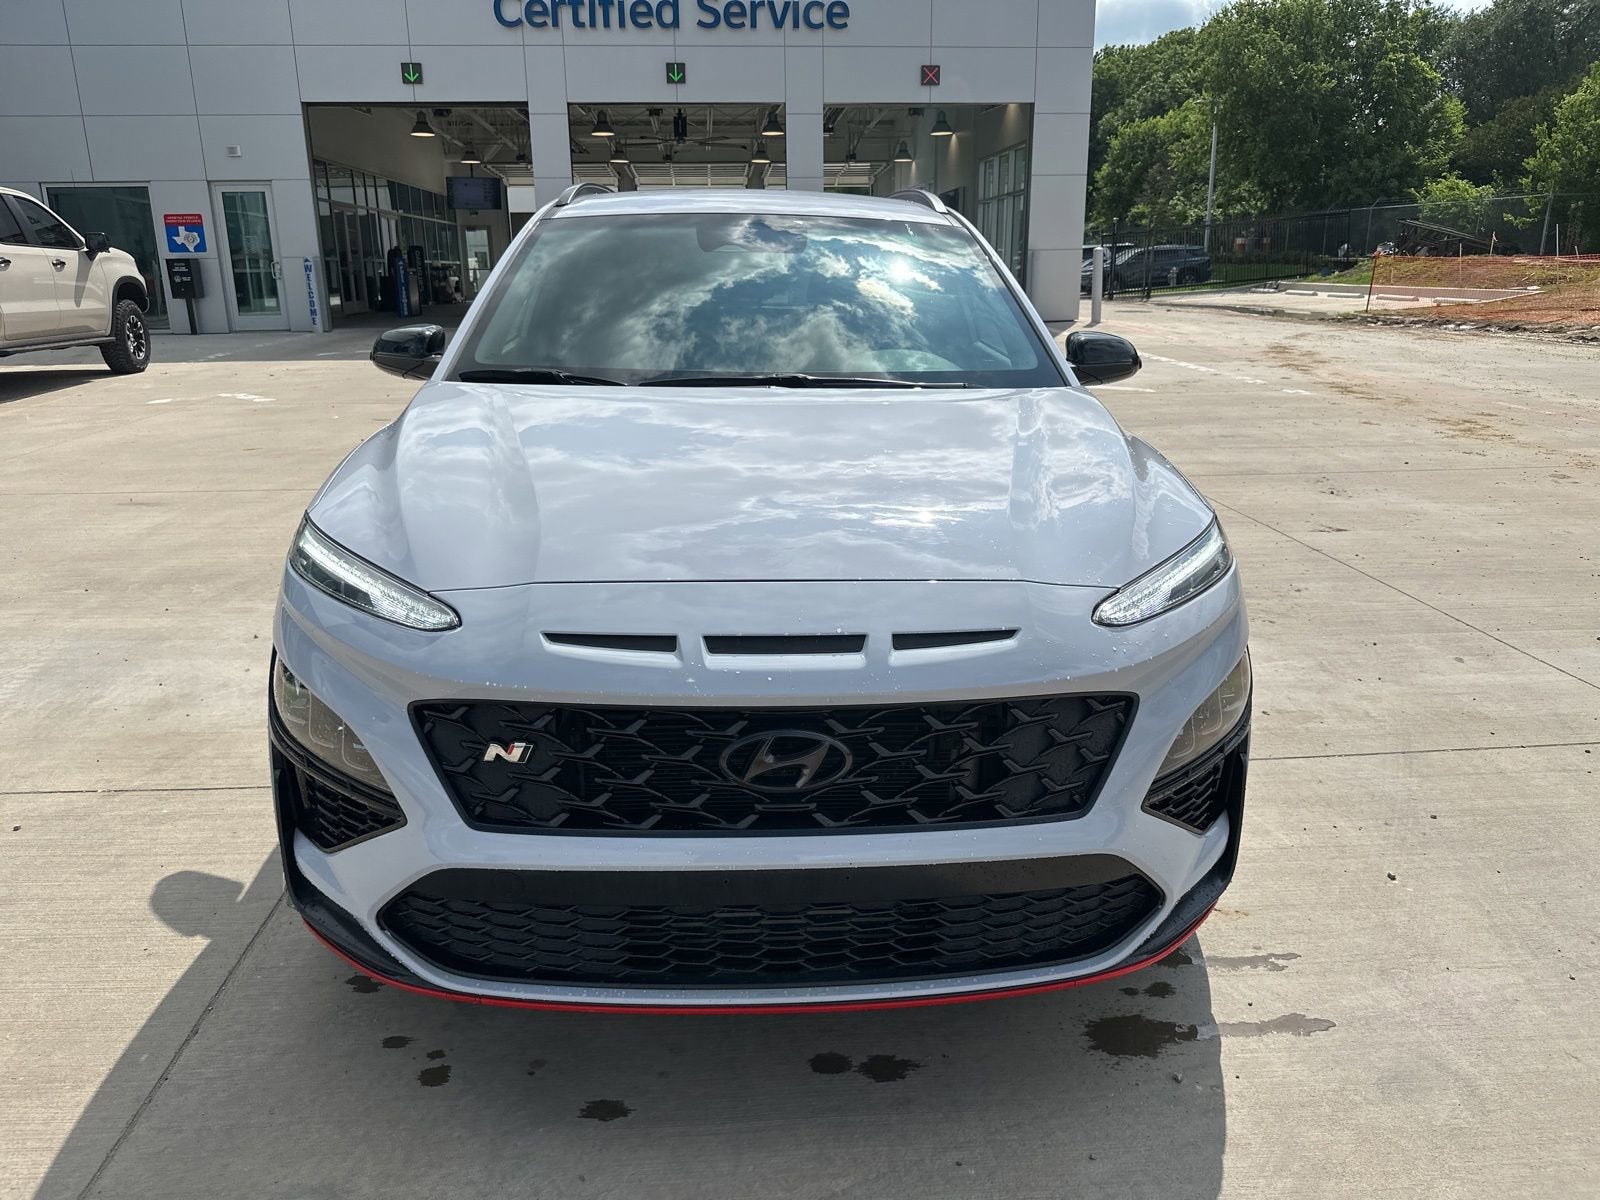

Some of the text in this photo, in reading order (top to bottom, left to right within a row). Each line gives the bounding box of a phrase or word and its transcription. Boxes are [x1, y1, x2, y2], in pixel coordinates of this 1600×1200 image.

[493, 0, 850, 30] Certified Service
[304, 264, 318, 326] WELCOME
